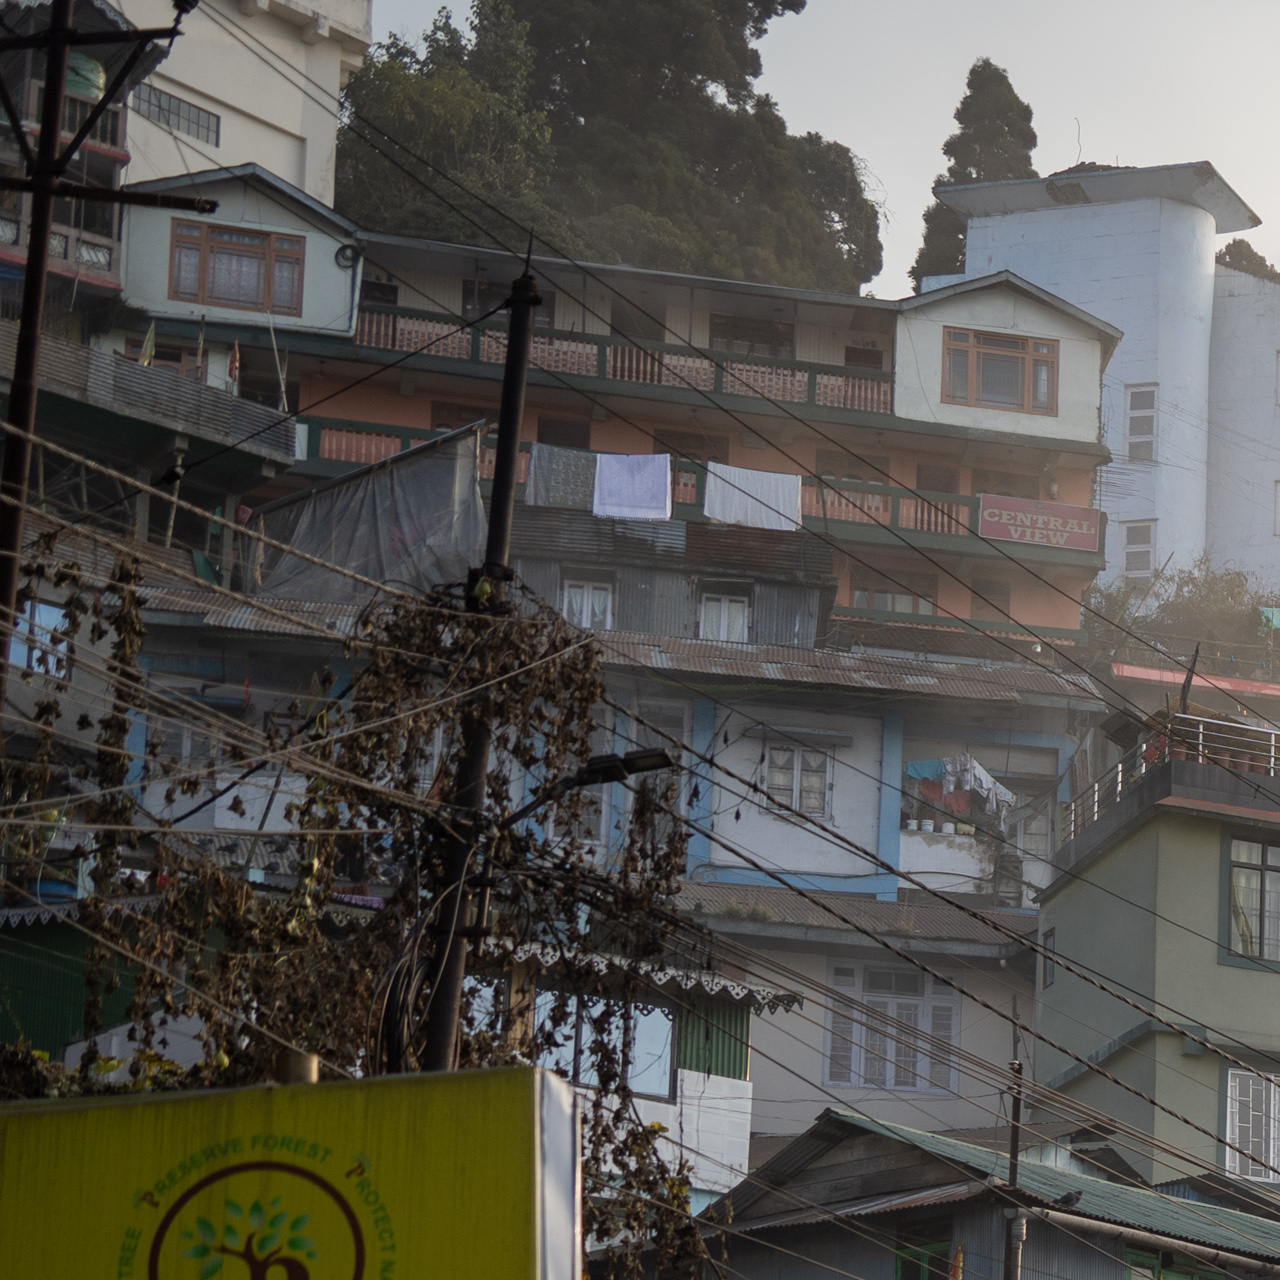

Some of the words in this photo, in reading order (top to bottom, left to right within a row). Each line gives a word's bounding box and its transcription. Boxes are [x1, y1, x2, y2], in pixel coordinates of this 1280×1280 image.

[983, 508, 1096, 535] CENTRAL
[1007, 525, 1070, 546] VIEW
[138, 1139, 245, 1208] PRESERVE
[250, 1134, 333, 1163] FOREST
[344, 1161, 396, 1253] PROTECT
[119, 1227, 143, 1280] TREE
